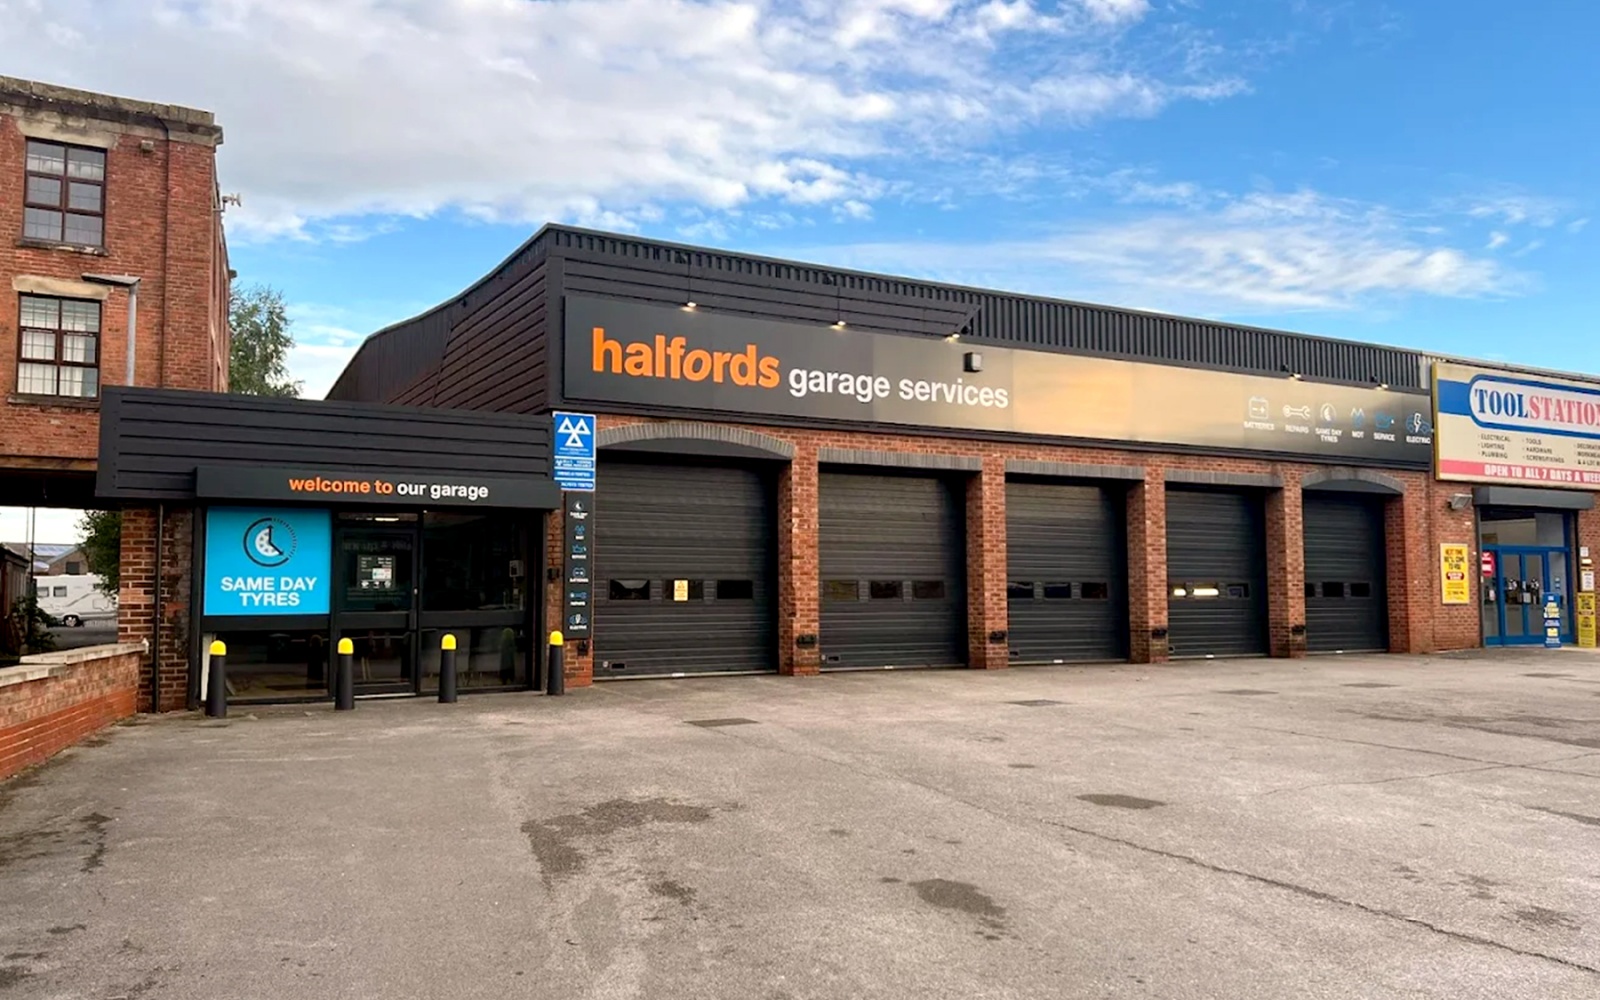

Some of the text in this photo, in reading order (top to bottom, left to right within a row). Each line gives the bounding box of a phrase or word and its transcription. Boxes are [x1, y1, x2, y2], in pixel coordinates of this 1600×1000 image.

[592, 327, 1008, 408] halfords garage services
[1484, 464, 1508, 476] OPEN
[1511, 466, 1522, 477] TO
[1525, 468, 1540, 478] ALL
[1542, 469, 1547, 479] 7
[1550, 470, 1572, 481] DAYS
[1574, 472, 1581, 481] A
[289, 477, 489, 499] welcome to our garage
[221, 577, 317, 591] SAME DAY
[239, 592, 300, 606] TYRES
